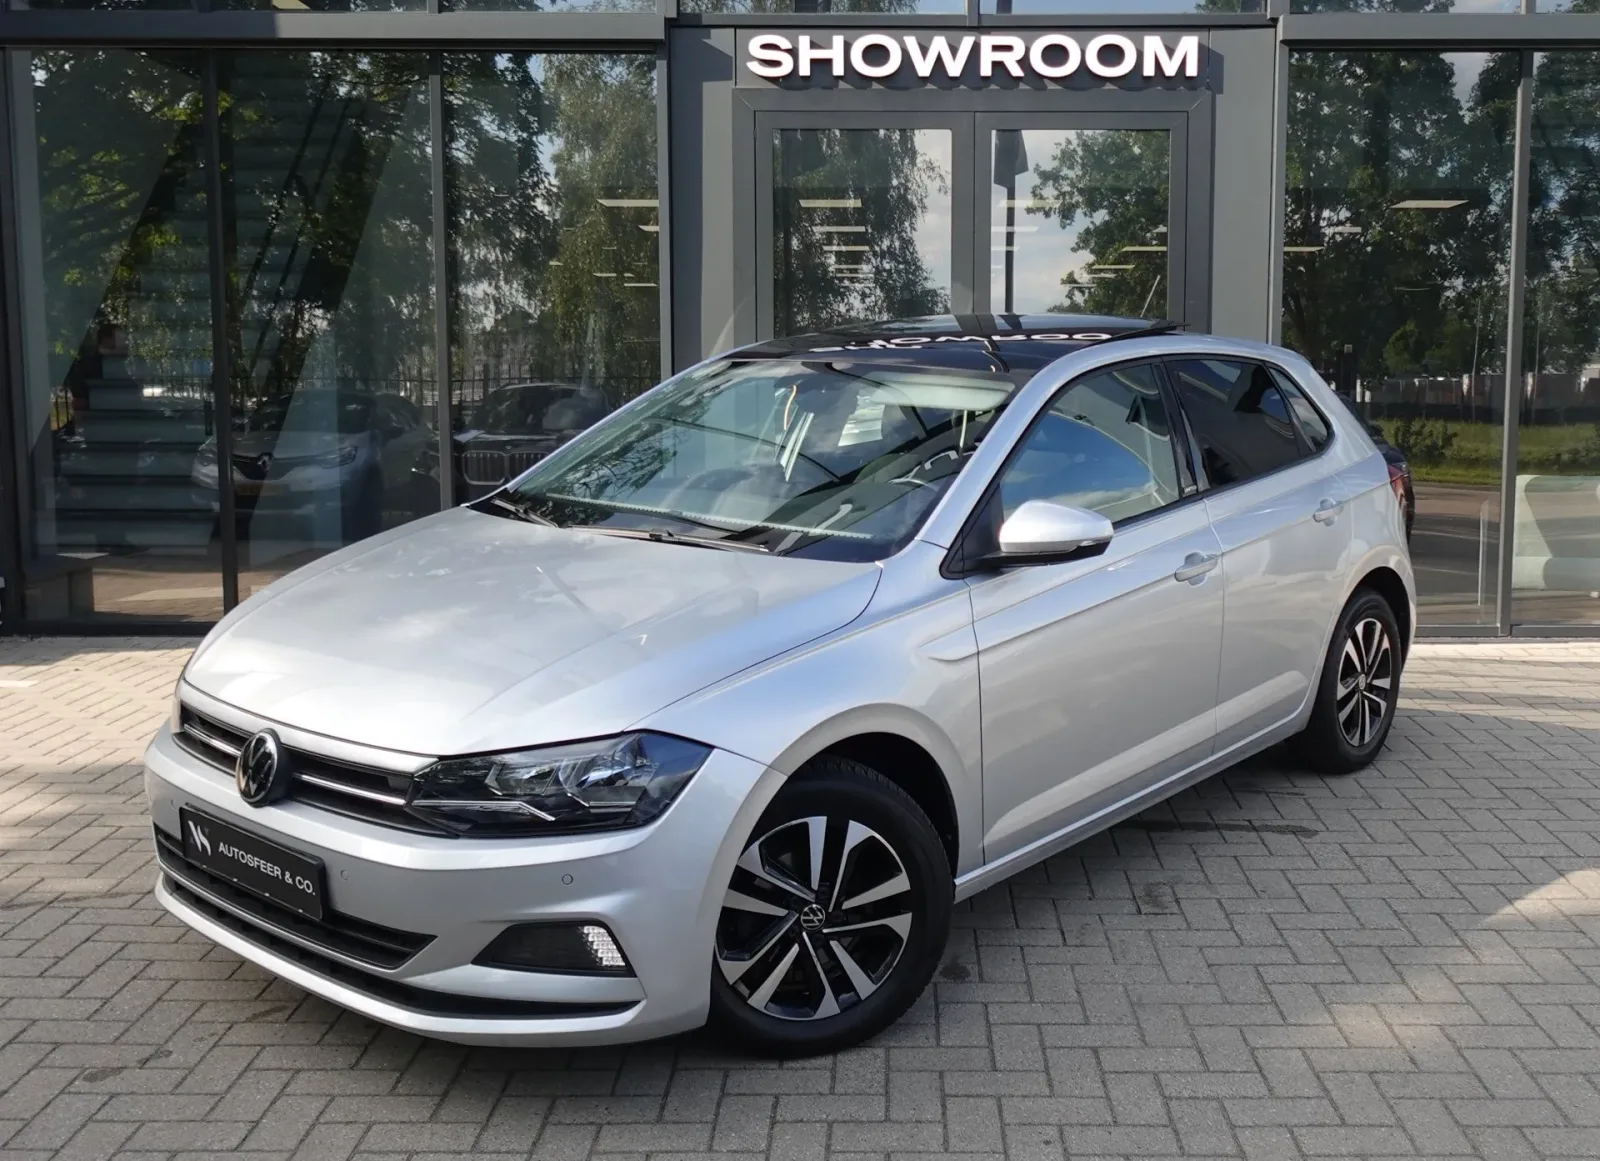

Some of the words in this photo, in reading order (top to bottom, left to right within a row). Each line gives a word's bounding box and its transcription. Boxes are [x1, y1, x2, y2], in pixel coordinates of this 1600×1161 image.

[746, 34, 1199, 78] SHOWROOM
[218, 842, 282, 880] AUTOSFEER
[284, 871, 294, 885] &
[295, 876, 316, 896] CO.
